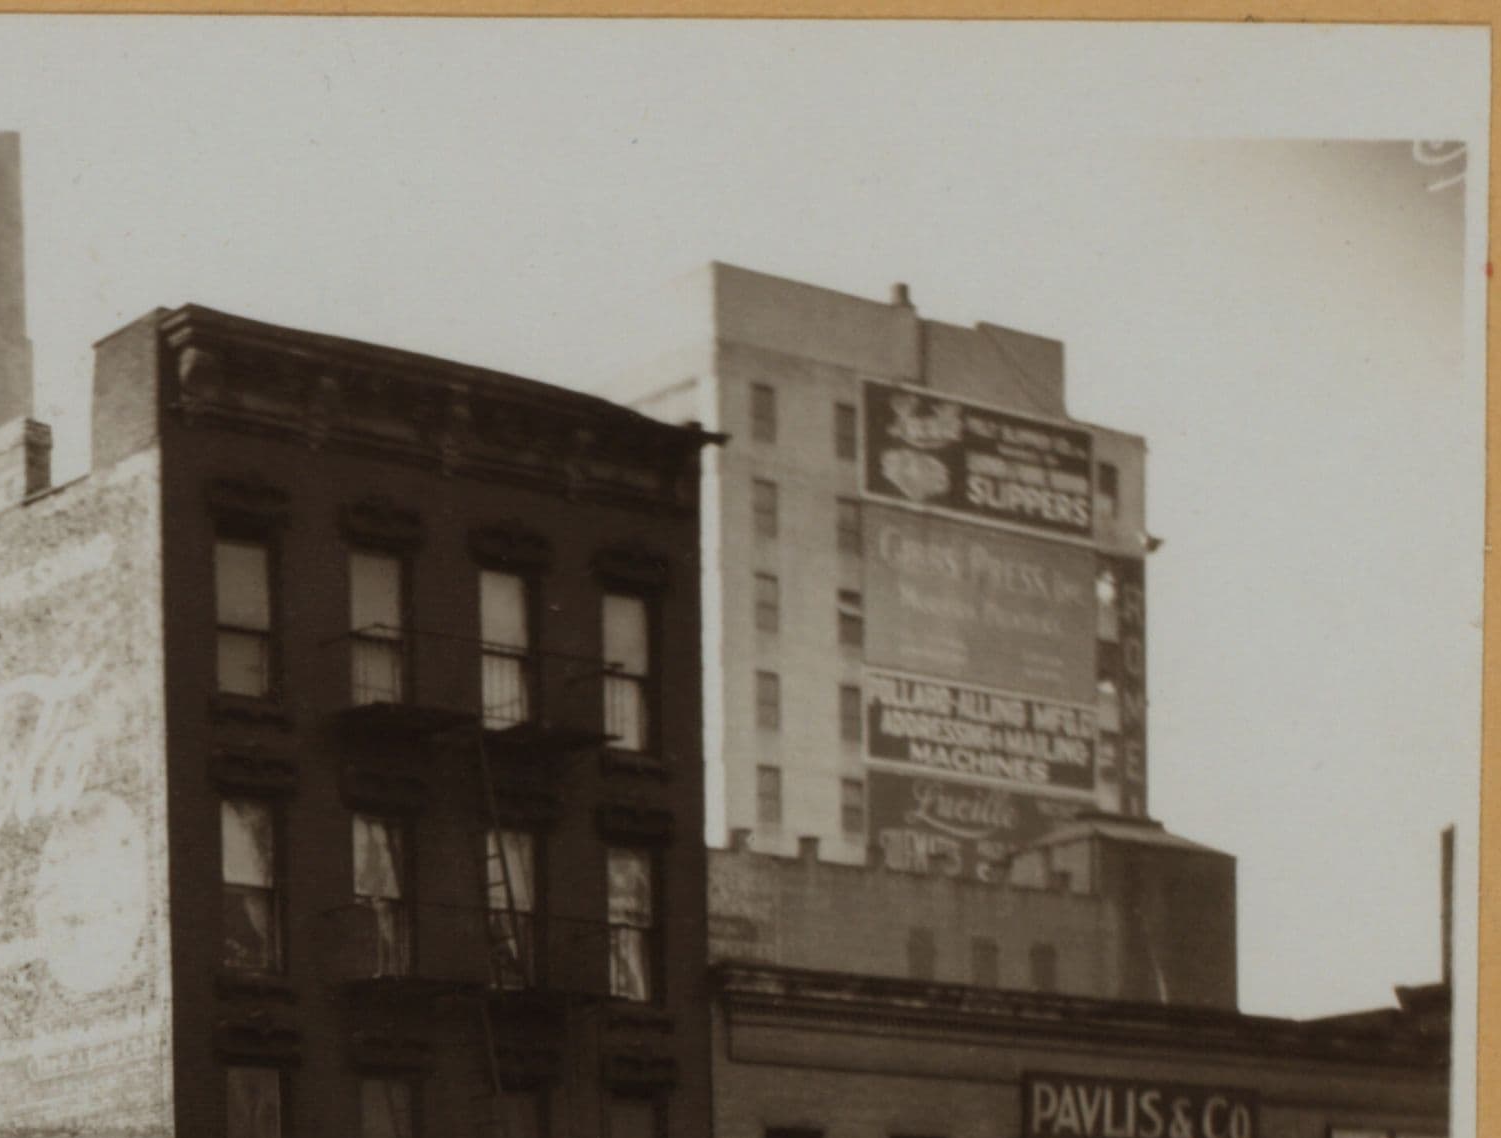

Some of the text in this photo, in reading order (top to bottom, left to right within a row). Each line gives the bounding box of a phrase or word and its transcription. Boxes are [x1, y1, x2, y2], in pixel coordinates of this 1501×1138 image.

[965, 476, 1089, 528] SLIPPERS
[907, 741, 1051, 783] MACHINES
[1031, 1080, 1163, 1138] PAVLIS
